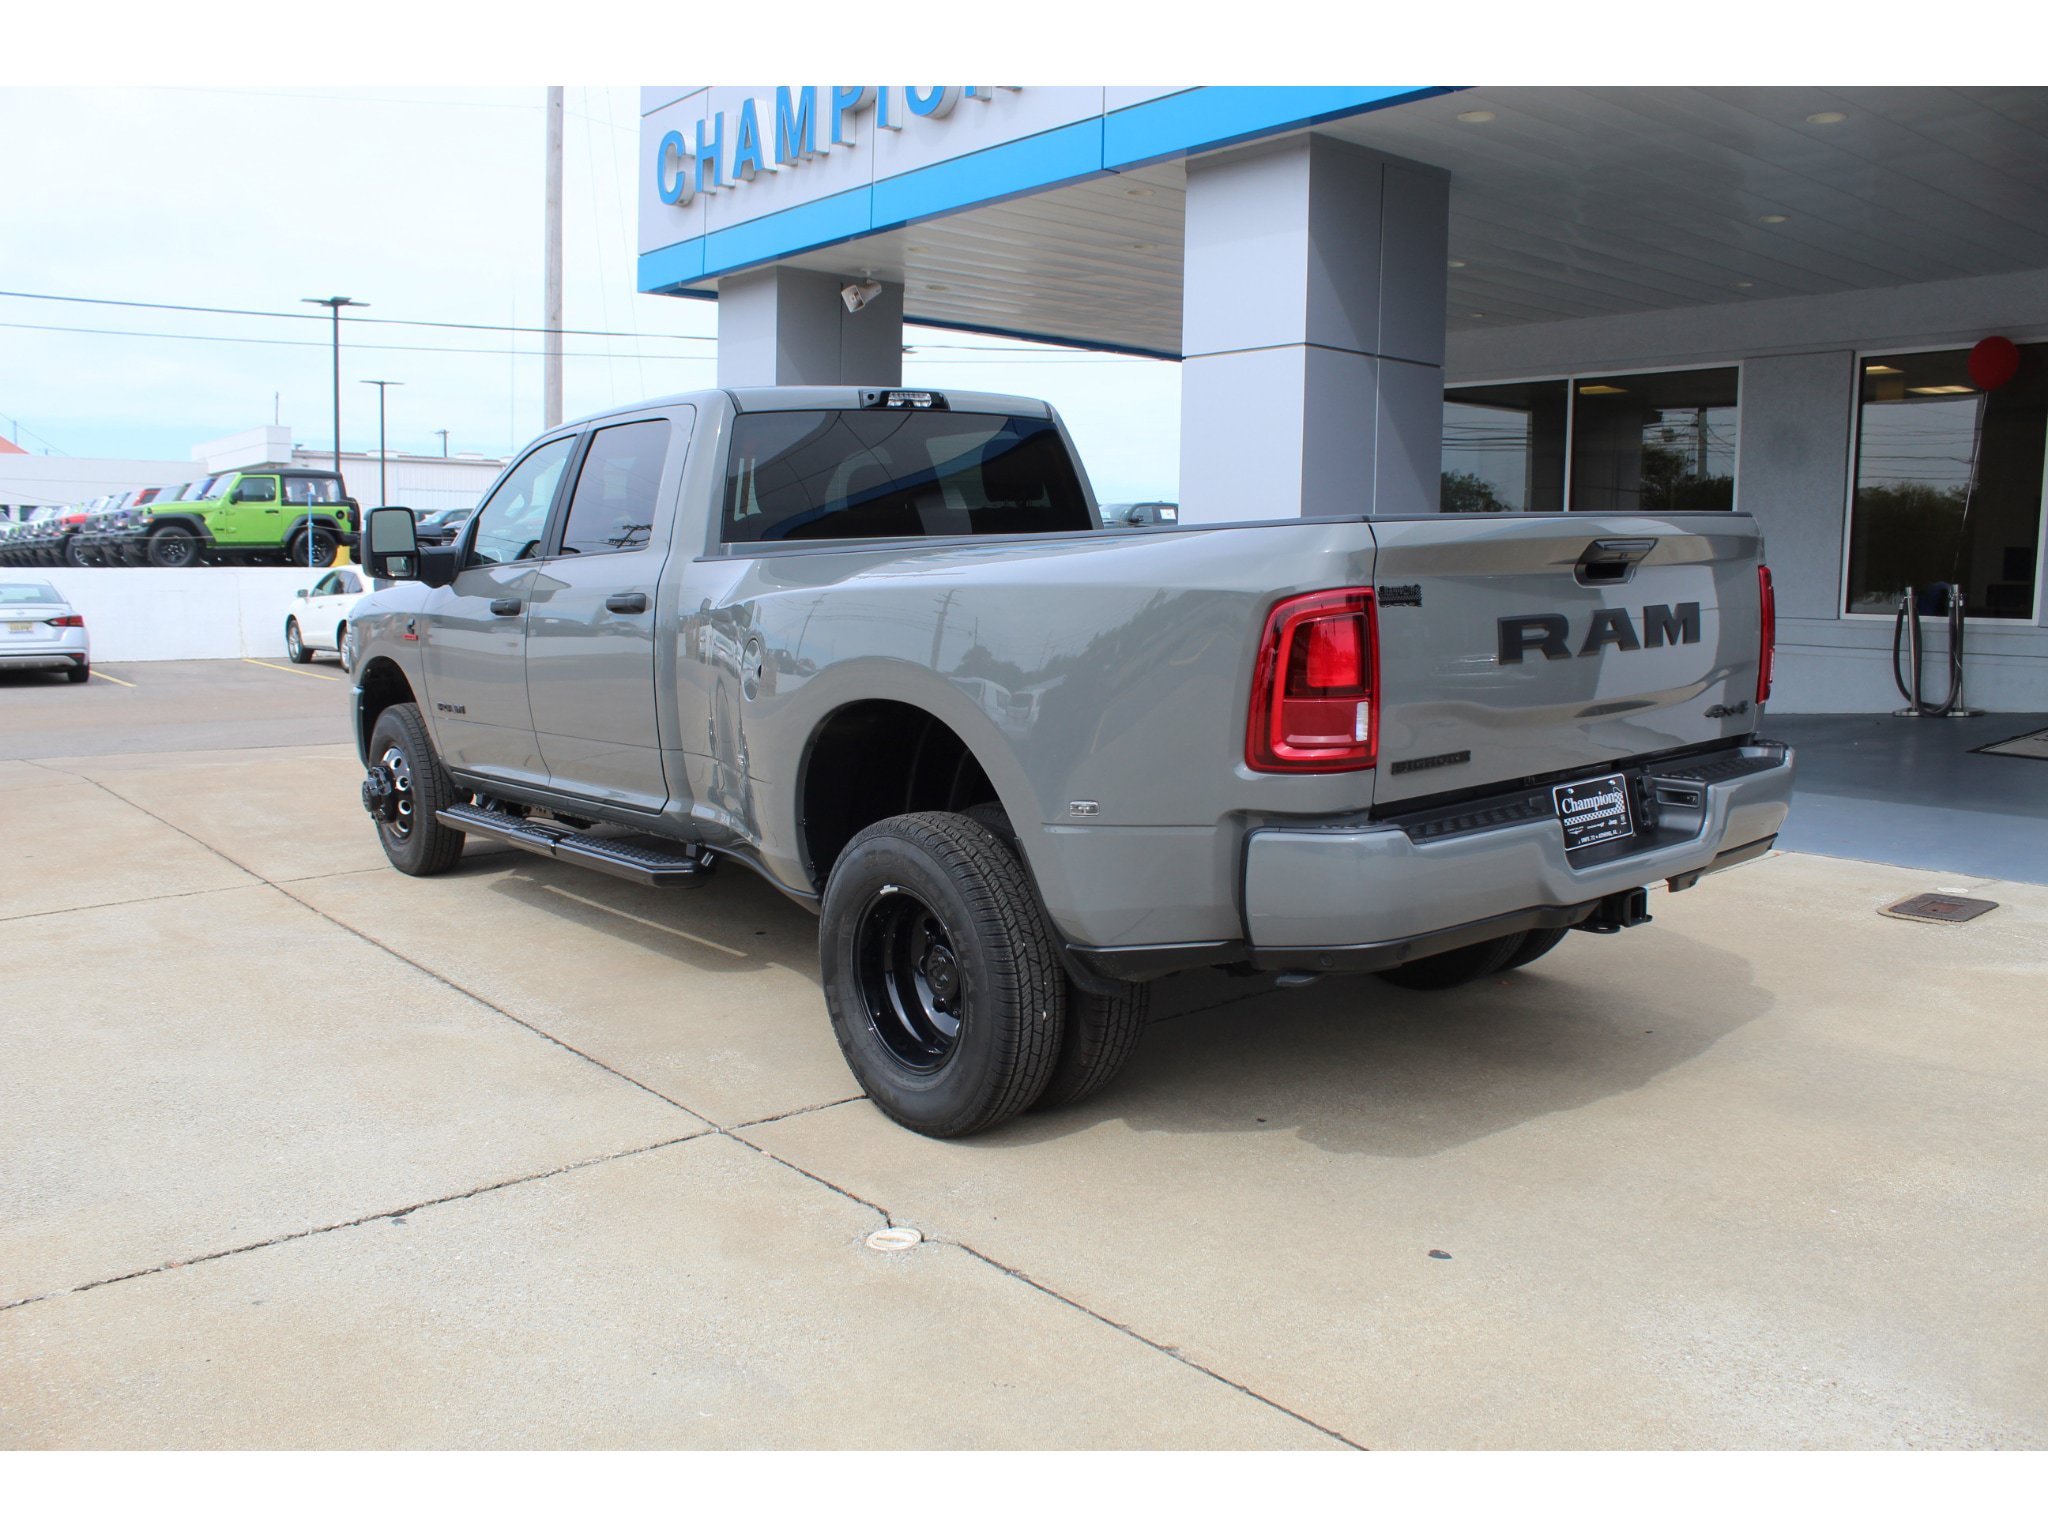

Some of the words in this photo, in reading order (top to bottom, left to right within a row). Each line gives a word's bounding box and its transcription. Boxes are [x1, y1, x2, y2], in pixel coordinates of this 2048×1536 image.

[657, 86, 1021, 206] CHAMPI
[1497, 602, 1700, 665] RAM
[1561, 791, 1616, 814] Champion
